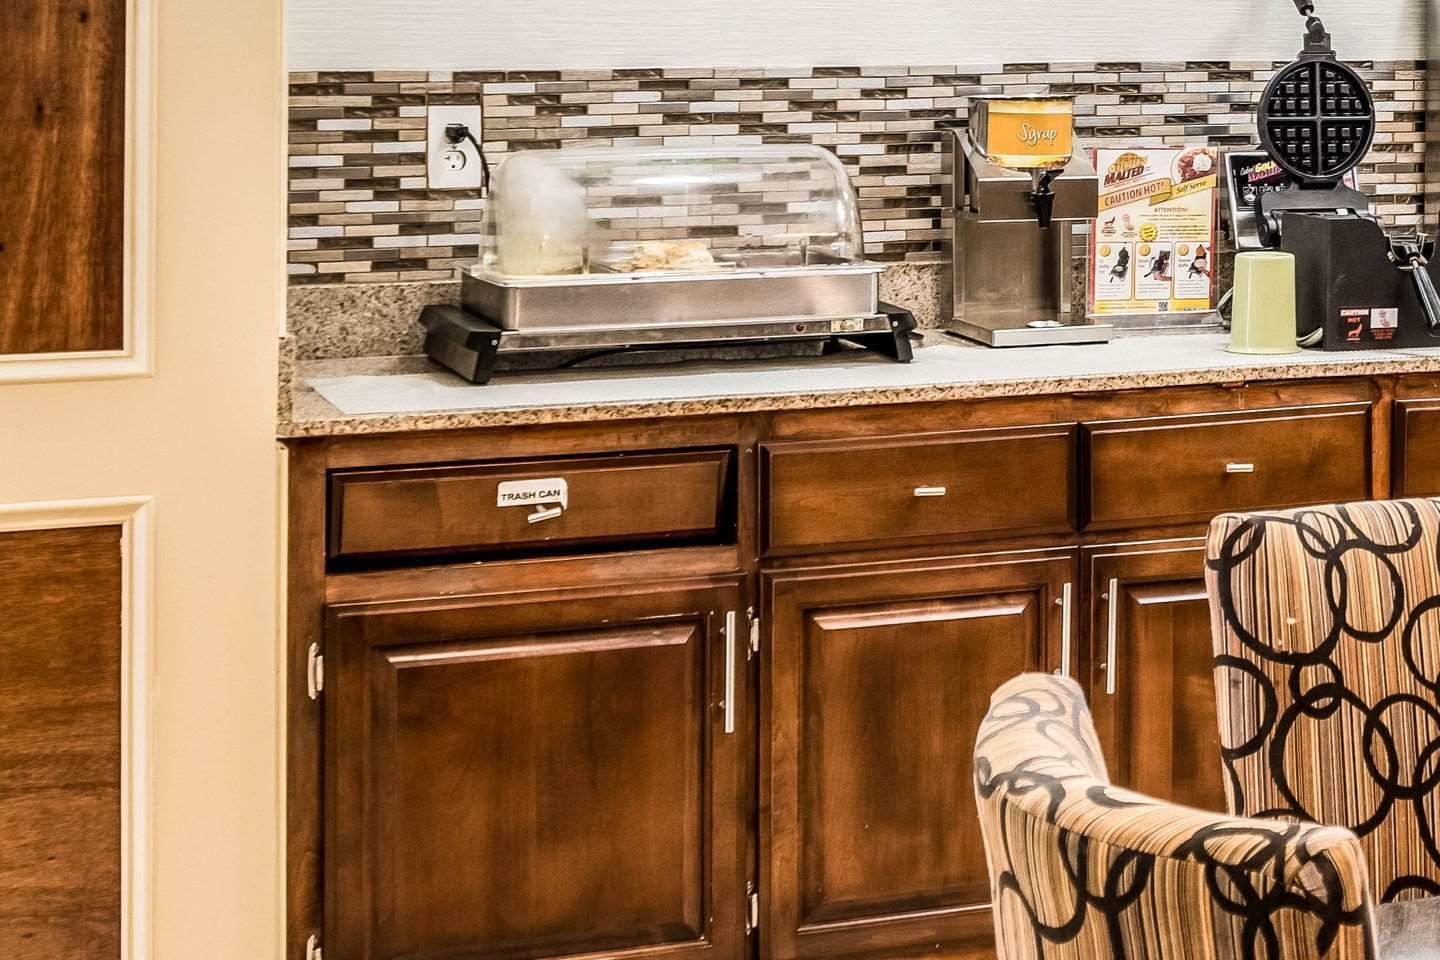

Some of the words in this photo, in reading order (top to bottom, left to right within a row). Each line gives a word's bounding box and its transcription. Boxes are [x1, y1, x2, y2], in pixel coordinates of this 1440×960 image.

[1018, 122, 1057, 146] Syrup
[1104, 165, 1145, 185] MALTED
[1104, 189, 1142, 206] CAUTION
[501, 491, 536, 502] TRASH
[538, 489, 561, 499] CAN
